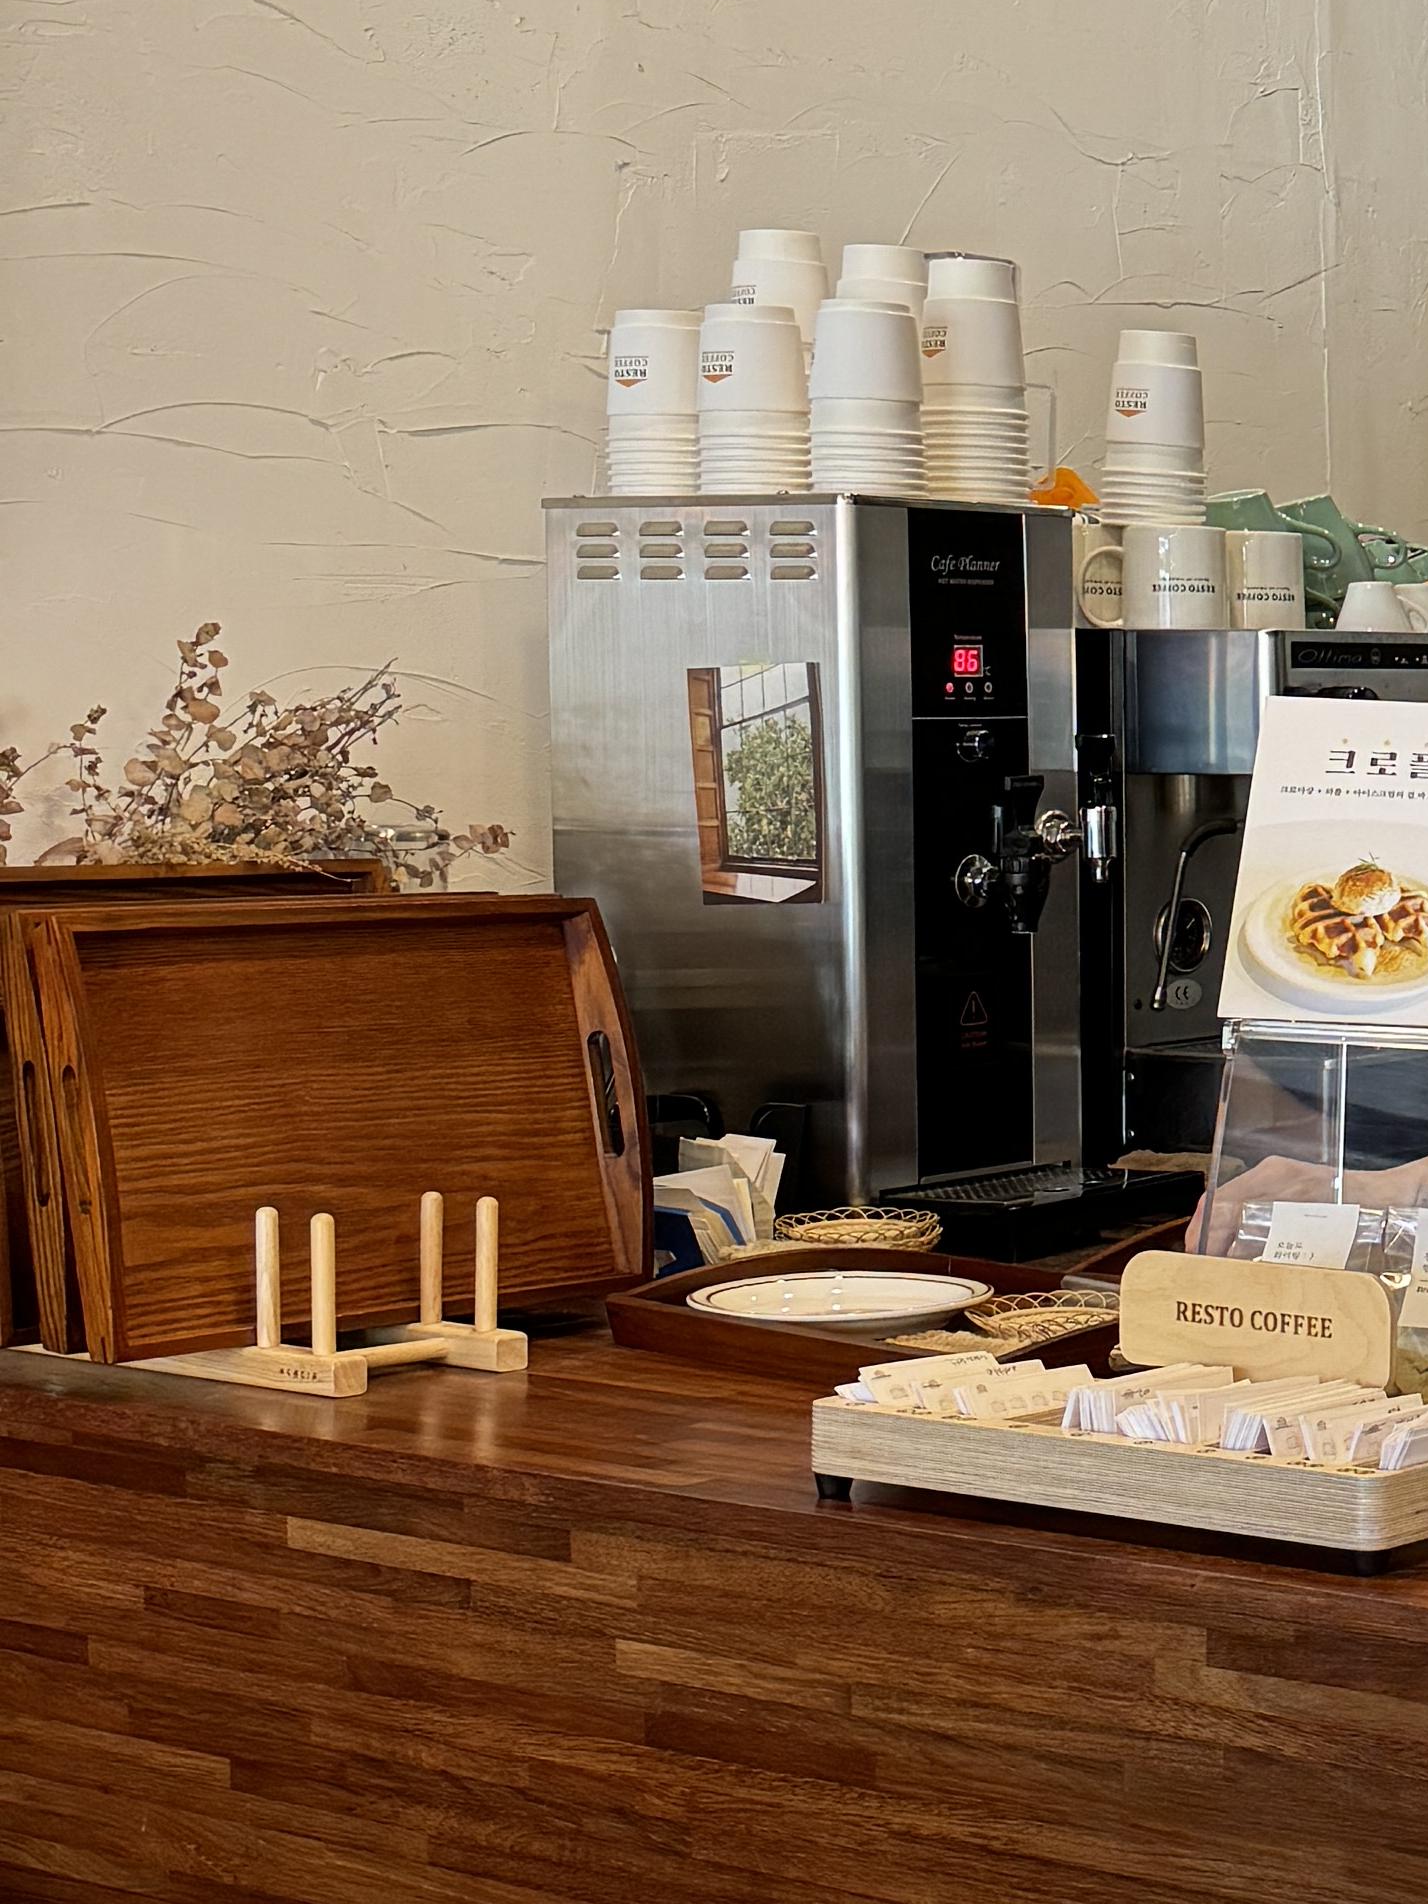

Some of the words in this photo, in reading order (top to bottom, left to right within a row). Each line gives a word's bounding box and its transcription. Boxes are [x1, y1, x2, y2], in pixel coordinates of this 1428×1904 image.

[931, 554, 957, 575] Cafe
[958, 554, 1001, 573] Planner
[953, 649, 979, 672] 86
[1175, 1299, 1245, 1329] RESTO
[1250, 1309, 1334, 1339] COFFEE
